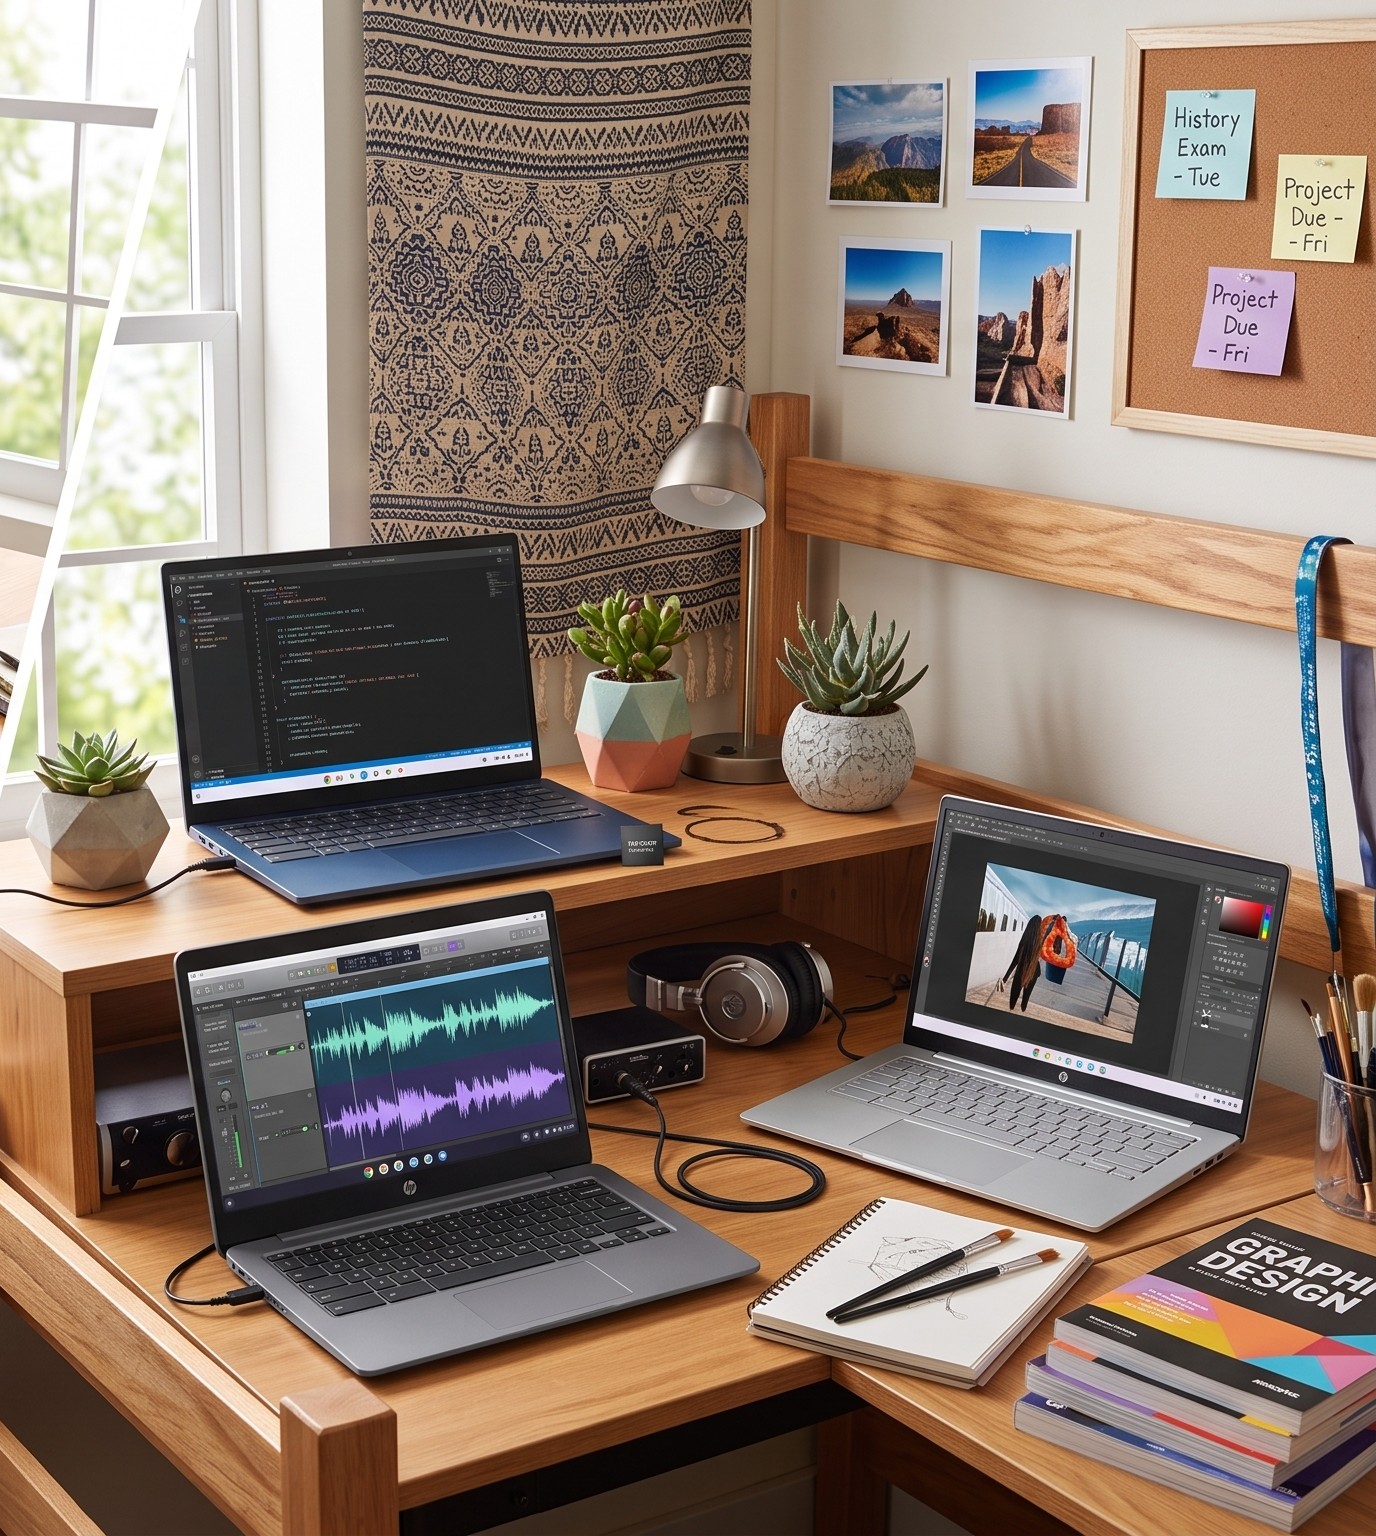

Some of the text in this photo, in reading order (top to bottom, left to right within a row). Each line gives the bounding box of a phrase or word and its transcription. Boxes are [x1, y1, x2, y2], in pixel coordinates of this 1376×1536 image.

[1175, 107, 1240, 137] History
[1178, 138, 1225, 156] Exam
[1188, 167, 1220, 187] Tue
[1285, 178, 1355, 206] Project
[1293, 207, 1326, 227] Due
[1304, 234, 1327, 252] Fri
[1213, 284, 1278, 312] Project
[1224, 315, 1258, 336] Due
[1224, 344, 1249, 363] Fri
[1197, 1250, 1362, 1314] DESIGN
